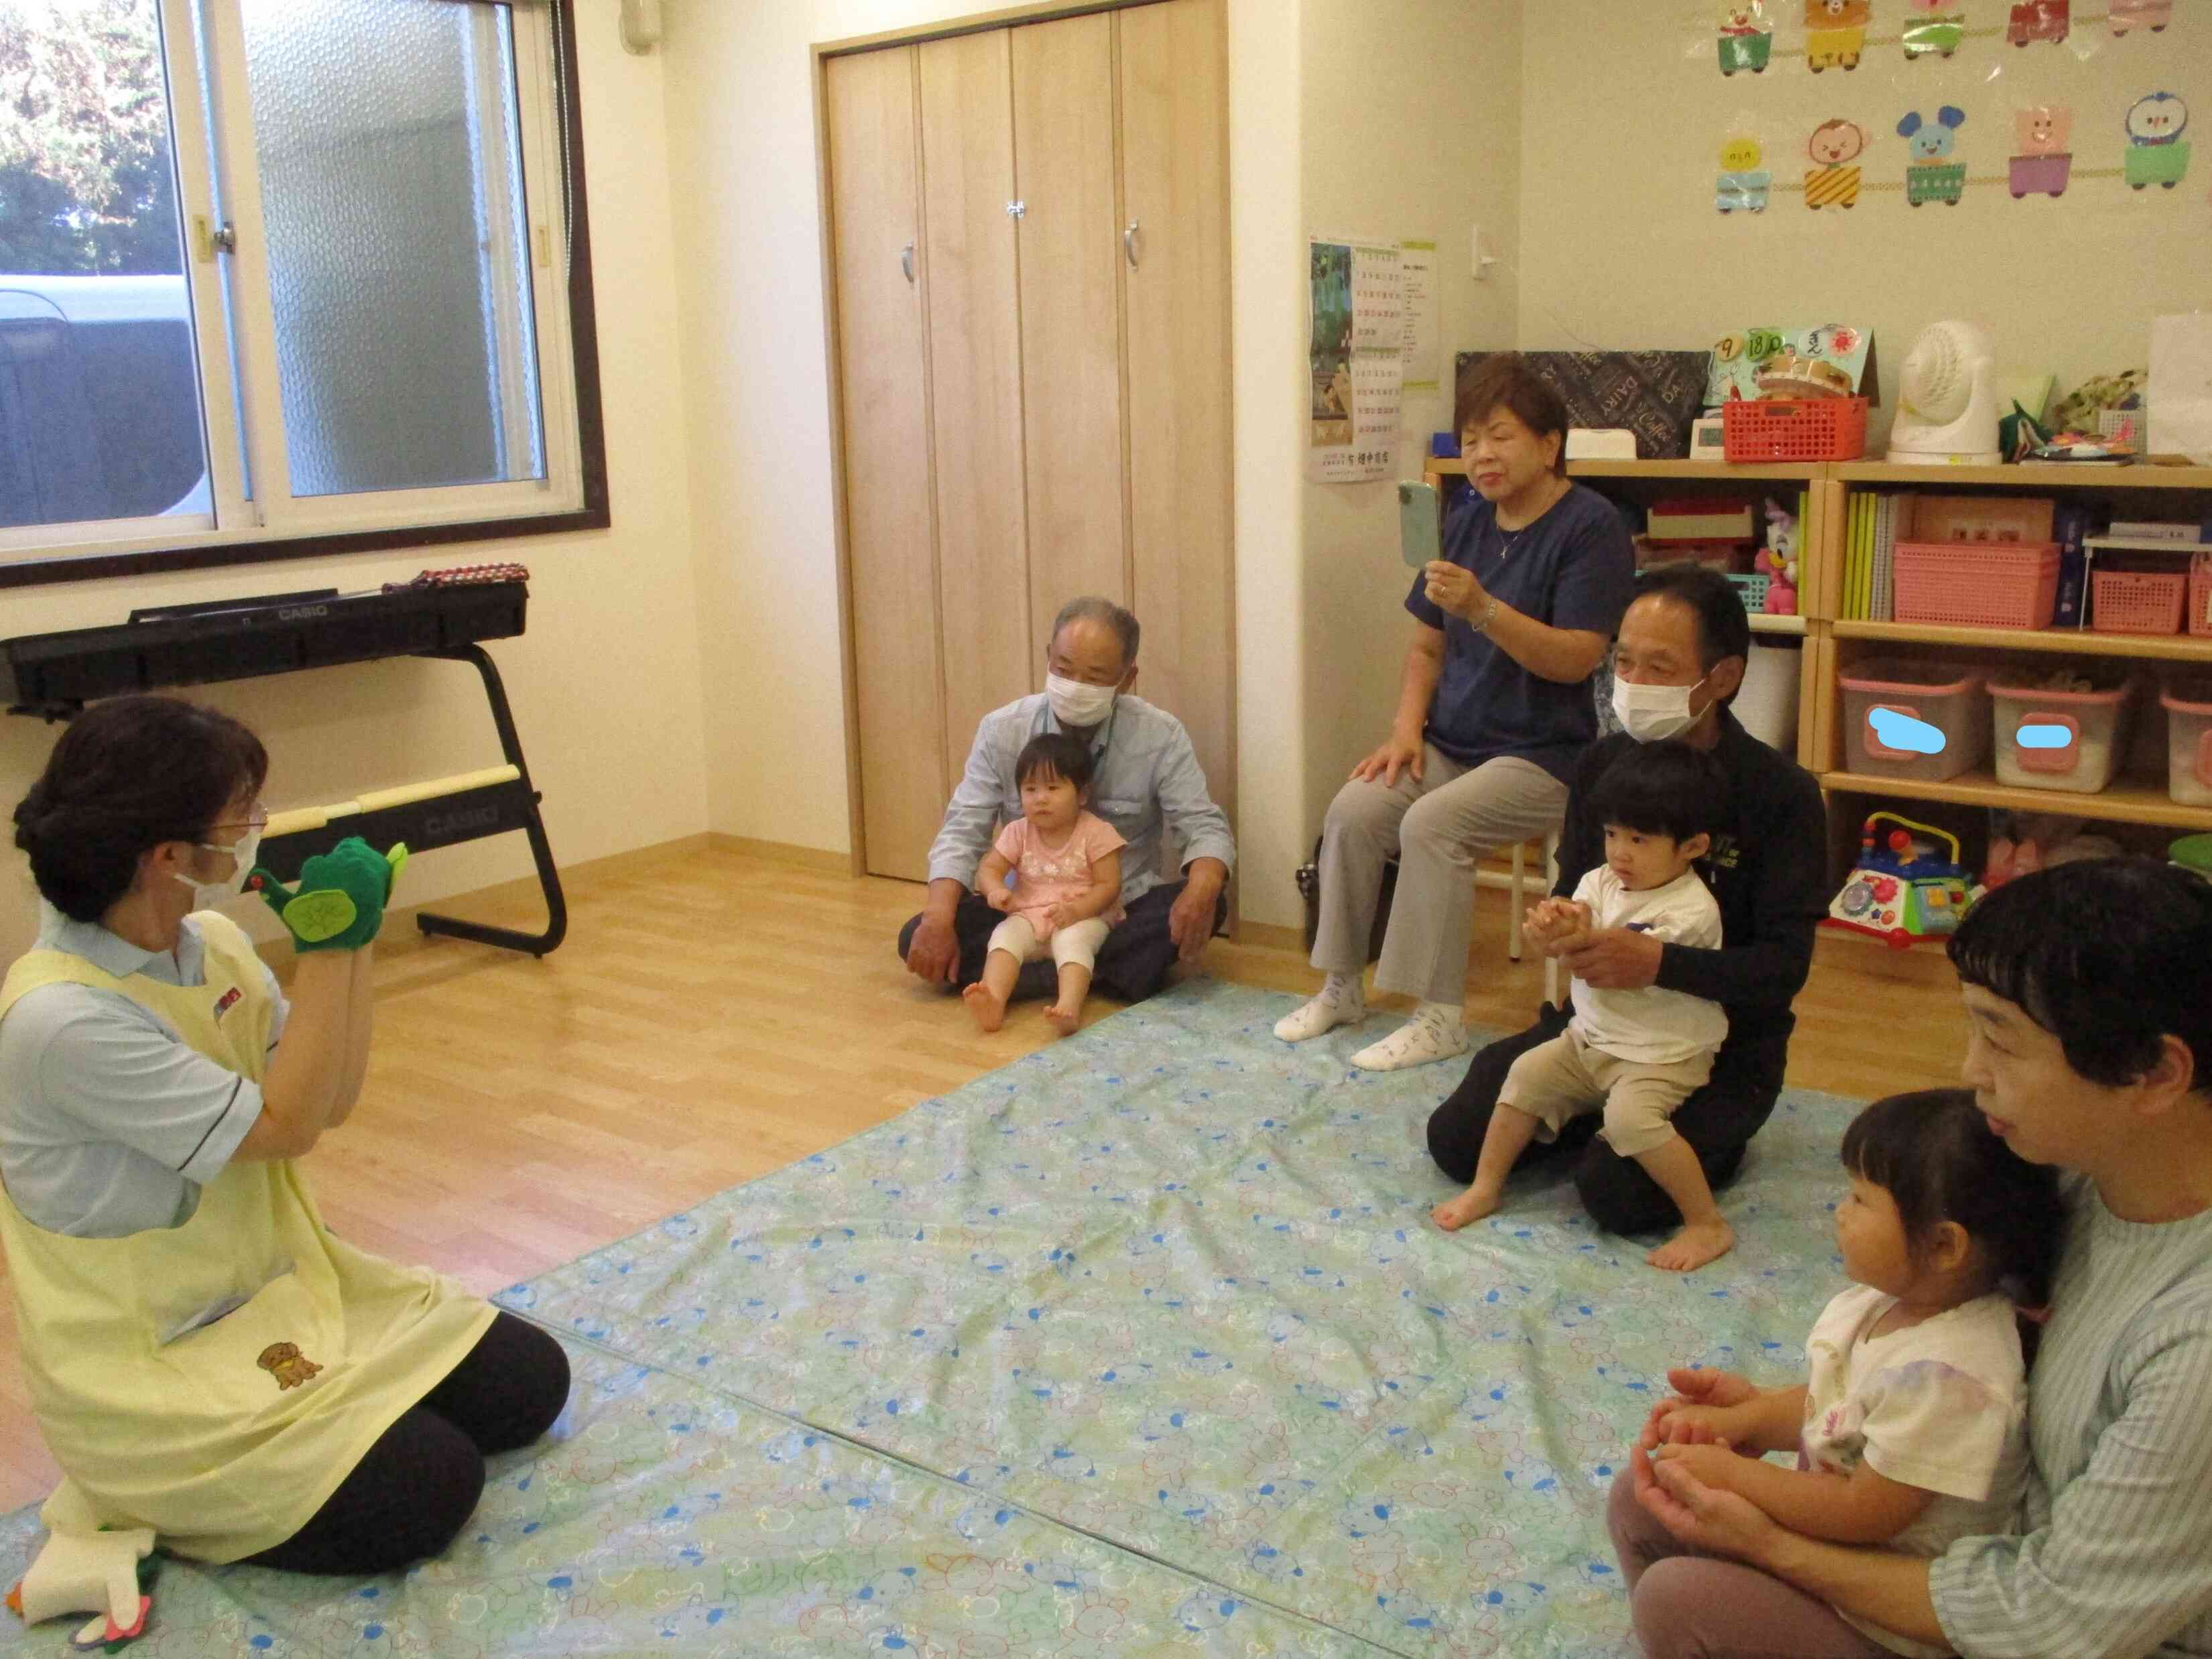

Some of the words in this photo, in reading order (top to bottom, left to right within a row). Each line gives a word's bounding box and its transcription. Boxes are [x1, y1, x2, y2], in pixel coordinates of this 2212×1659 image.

[1721, 339, 1733, 357] 9
[1749, 336, 1763, 357] 18
[279, 605, 328, 621] CASIO
